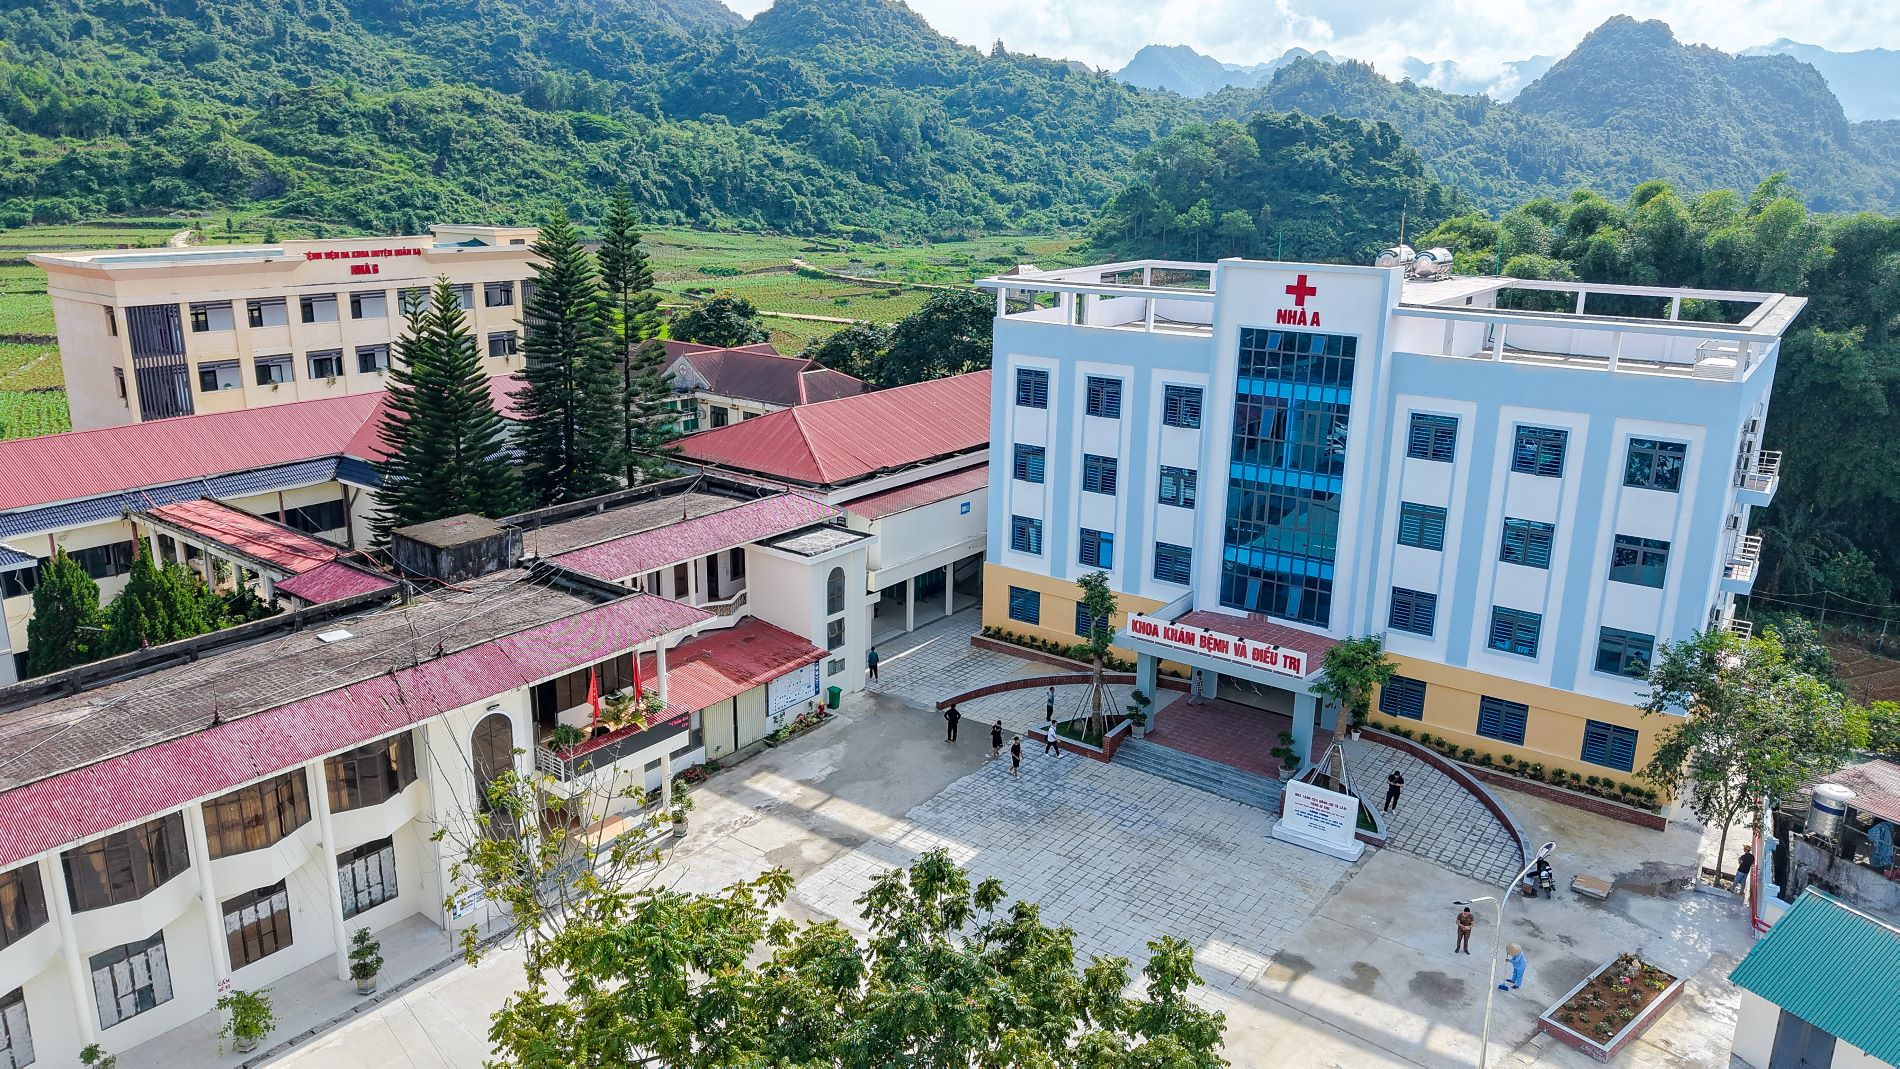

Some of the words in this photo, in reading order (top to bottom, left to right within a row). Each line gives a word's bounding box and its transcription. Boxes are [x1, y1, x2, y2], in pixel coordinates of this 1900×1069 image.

[1276, 307, 1307, 326] NHÀ
[1309, 311, 1321, 327] A
[1131, 619, 1159, 638] KHOA
[1163, 626, 1196, 647] KHÁM
[1199, 634, 1229, 654] BỆNH
[1233, 641, 1248, 659] VÀ
[1251, 646, 1278, 666] ĐIỀU
[1283, 654, 1301, 674] TRỊ
